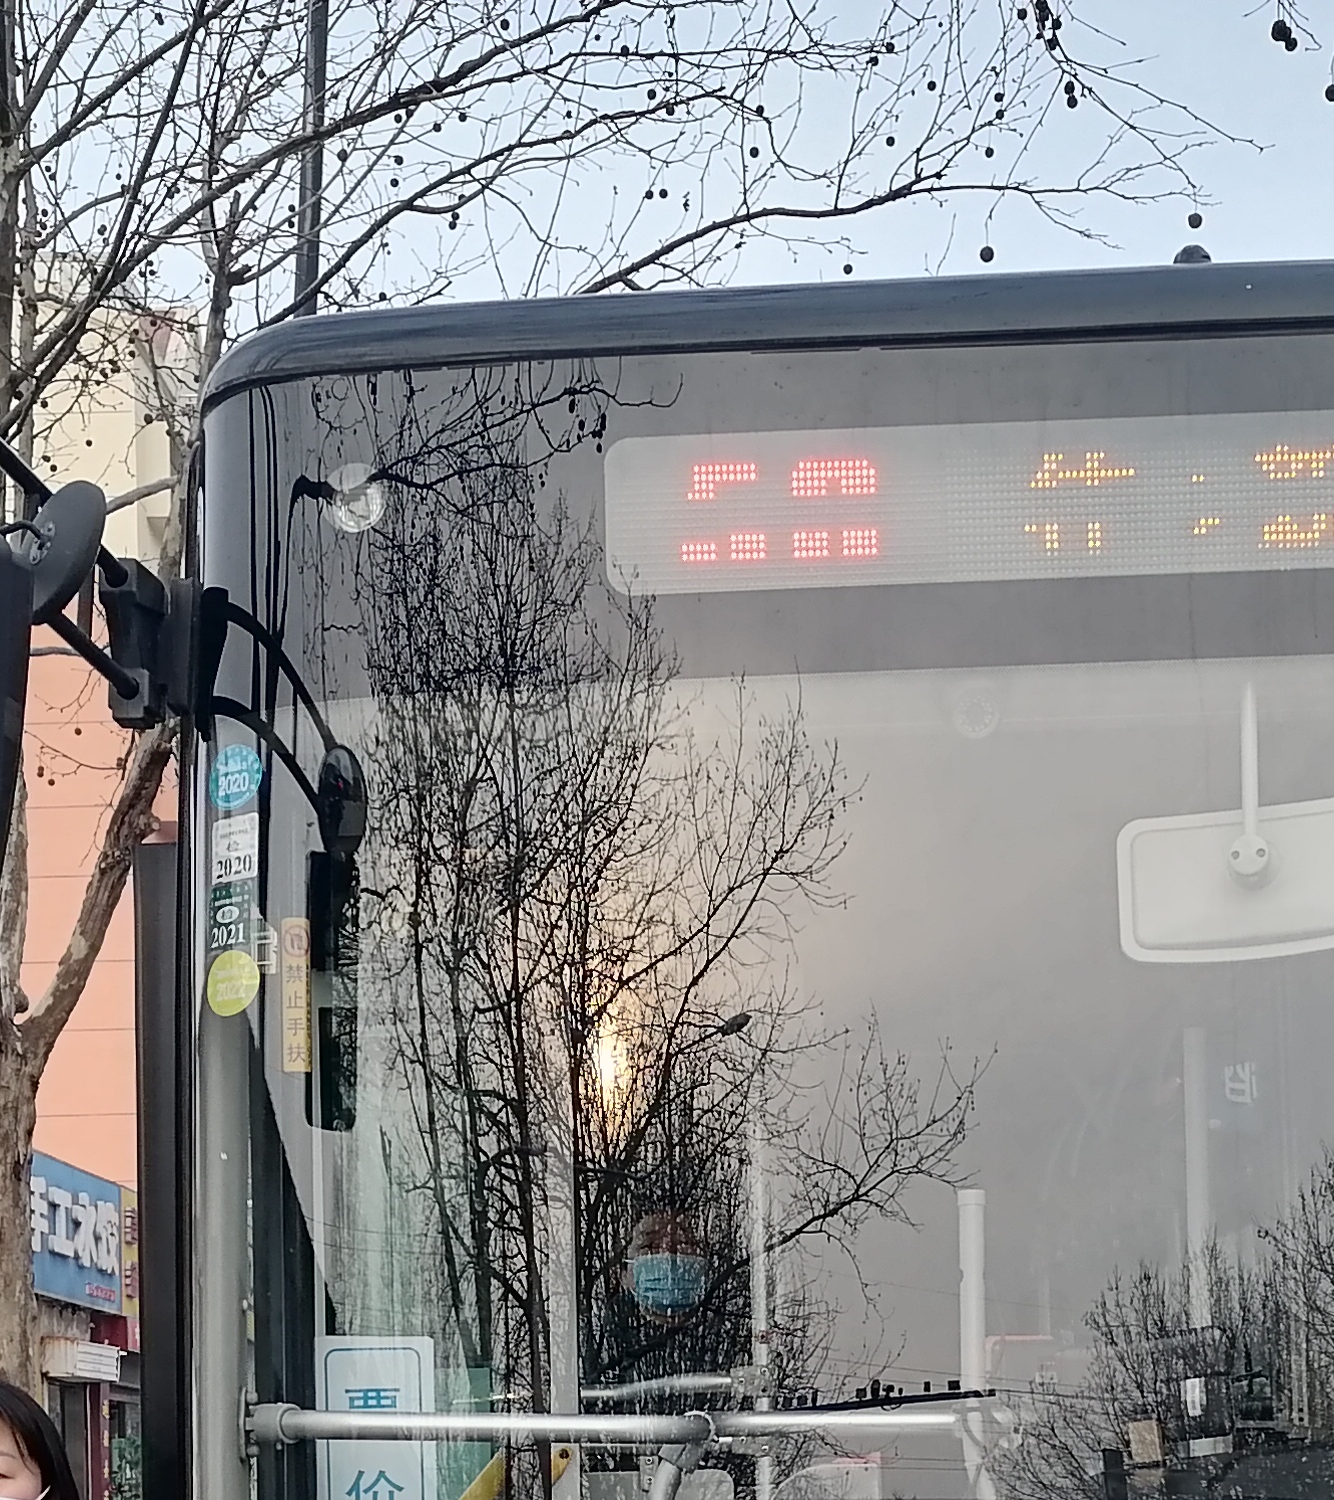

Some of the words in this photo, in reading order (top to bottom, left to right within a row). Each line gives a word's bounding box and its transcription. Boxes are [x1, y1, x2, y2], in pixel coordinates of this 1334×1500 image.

[218, 771, 249, 797] 2020
[216, 854, 252, 879] 2020
[210, 922, 246, 949] 2021
[285, 963, 306, 1063] 禁止手扶
